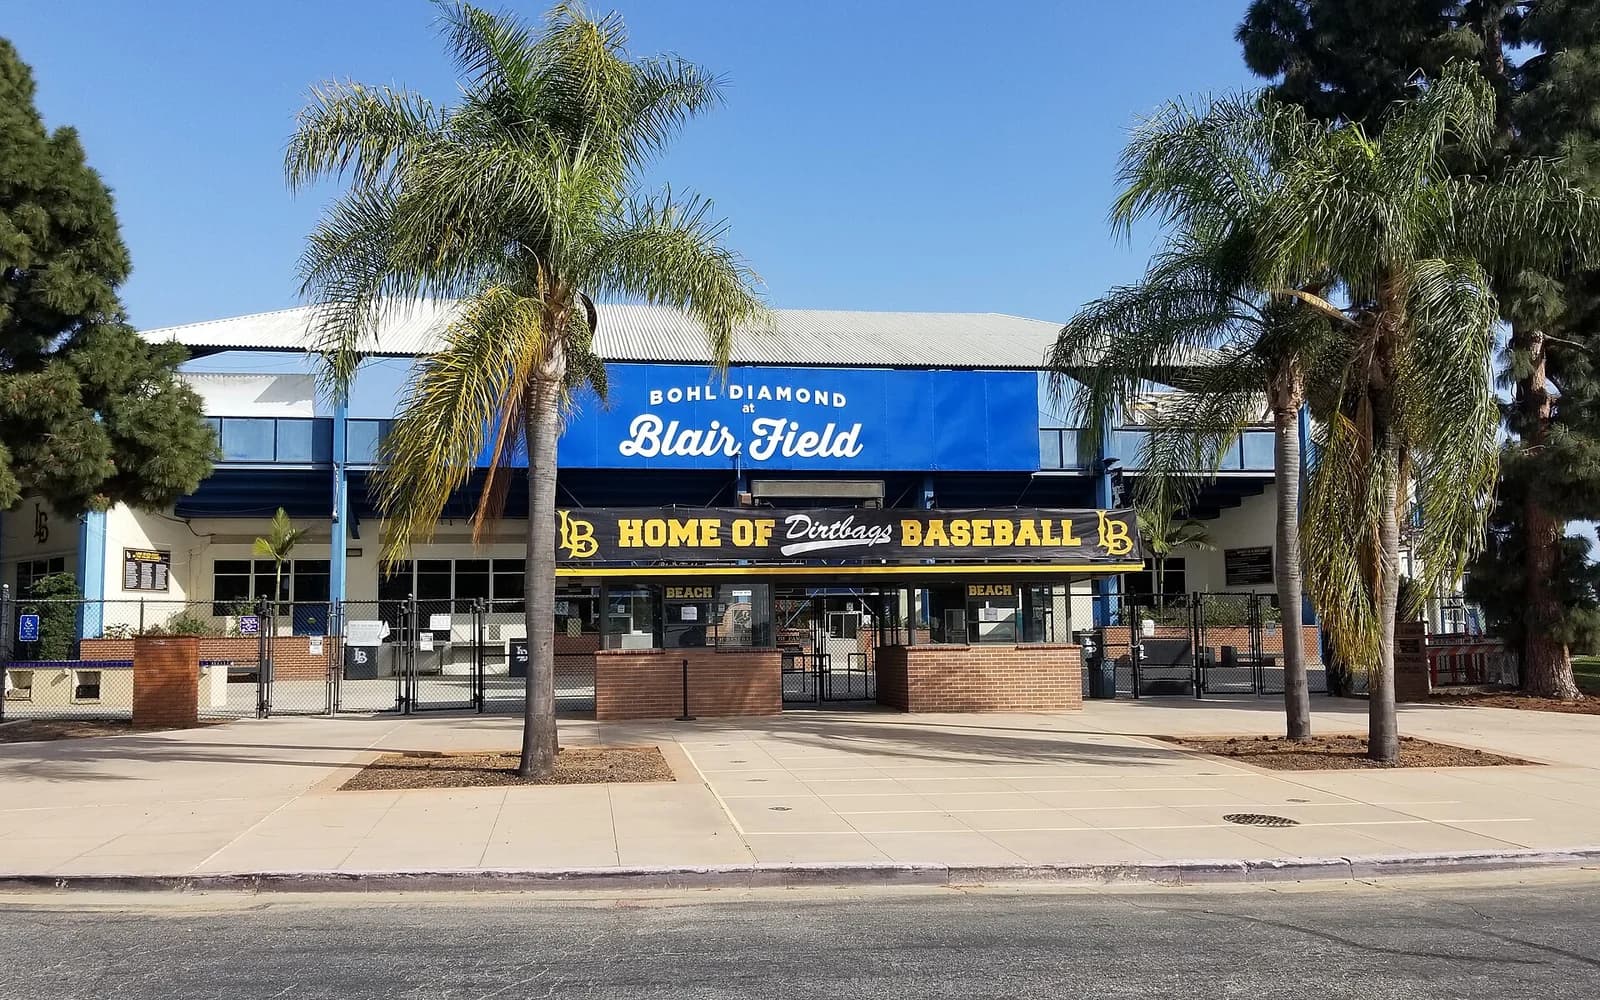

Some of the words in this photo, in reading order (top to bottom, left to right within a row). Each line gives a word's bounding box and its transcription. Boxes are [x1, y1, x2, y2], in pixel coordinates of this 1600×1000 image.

[650, 386, 716, 405] BOHL
[729, 385, 847, 408] DIAMOND
[742, 403, 755, 413] at
[619, 413, 742, 458] Blair
[749, 417, 864, 461] Field
[557, 510, 599, 559] LB
[618, 519, 721, 547] HOME
[732, 519, 775, 547] OF
[785, 514, 892, 545] Dirtbags
[901, 519, 1082, 547] BASEBALL
[1096, 510, 1134, 556] LB
[665, 587, 713, 599] BEACH
[968, 584, 1013, 596] BEACH
